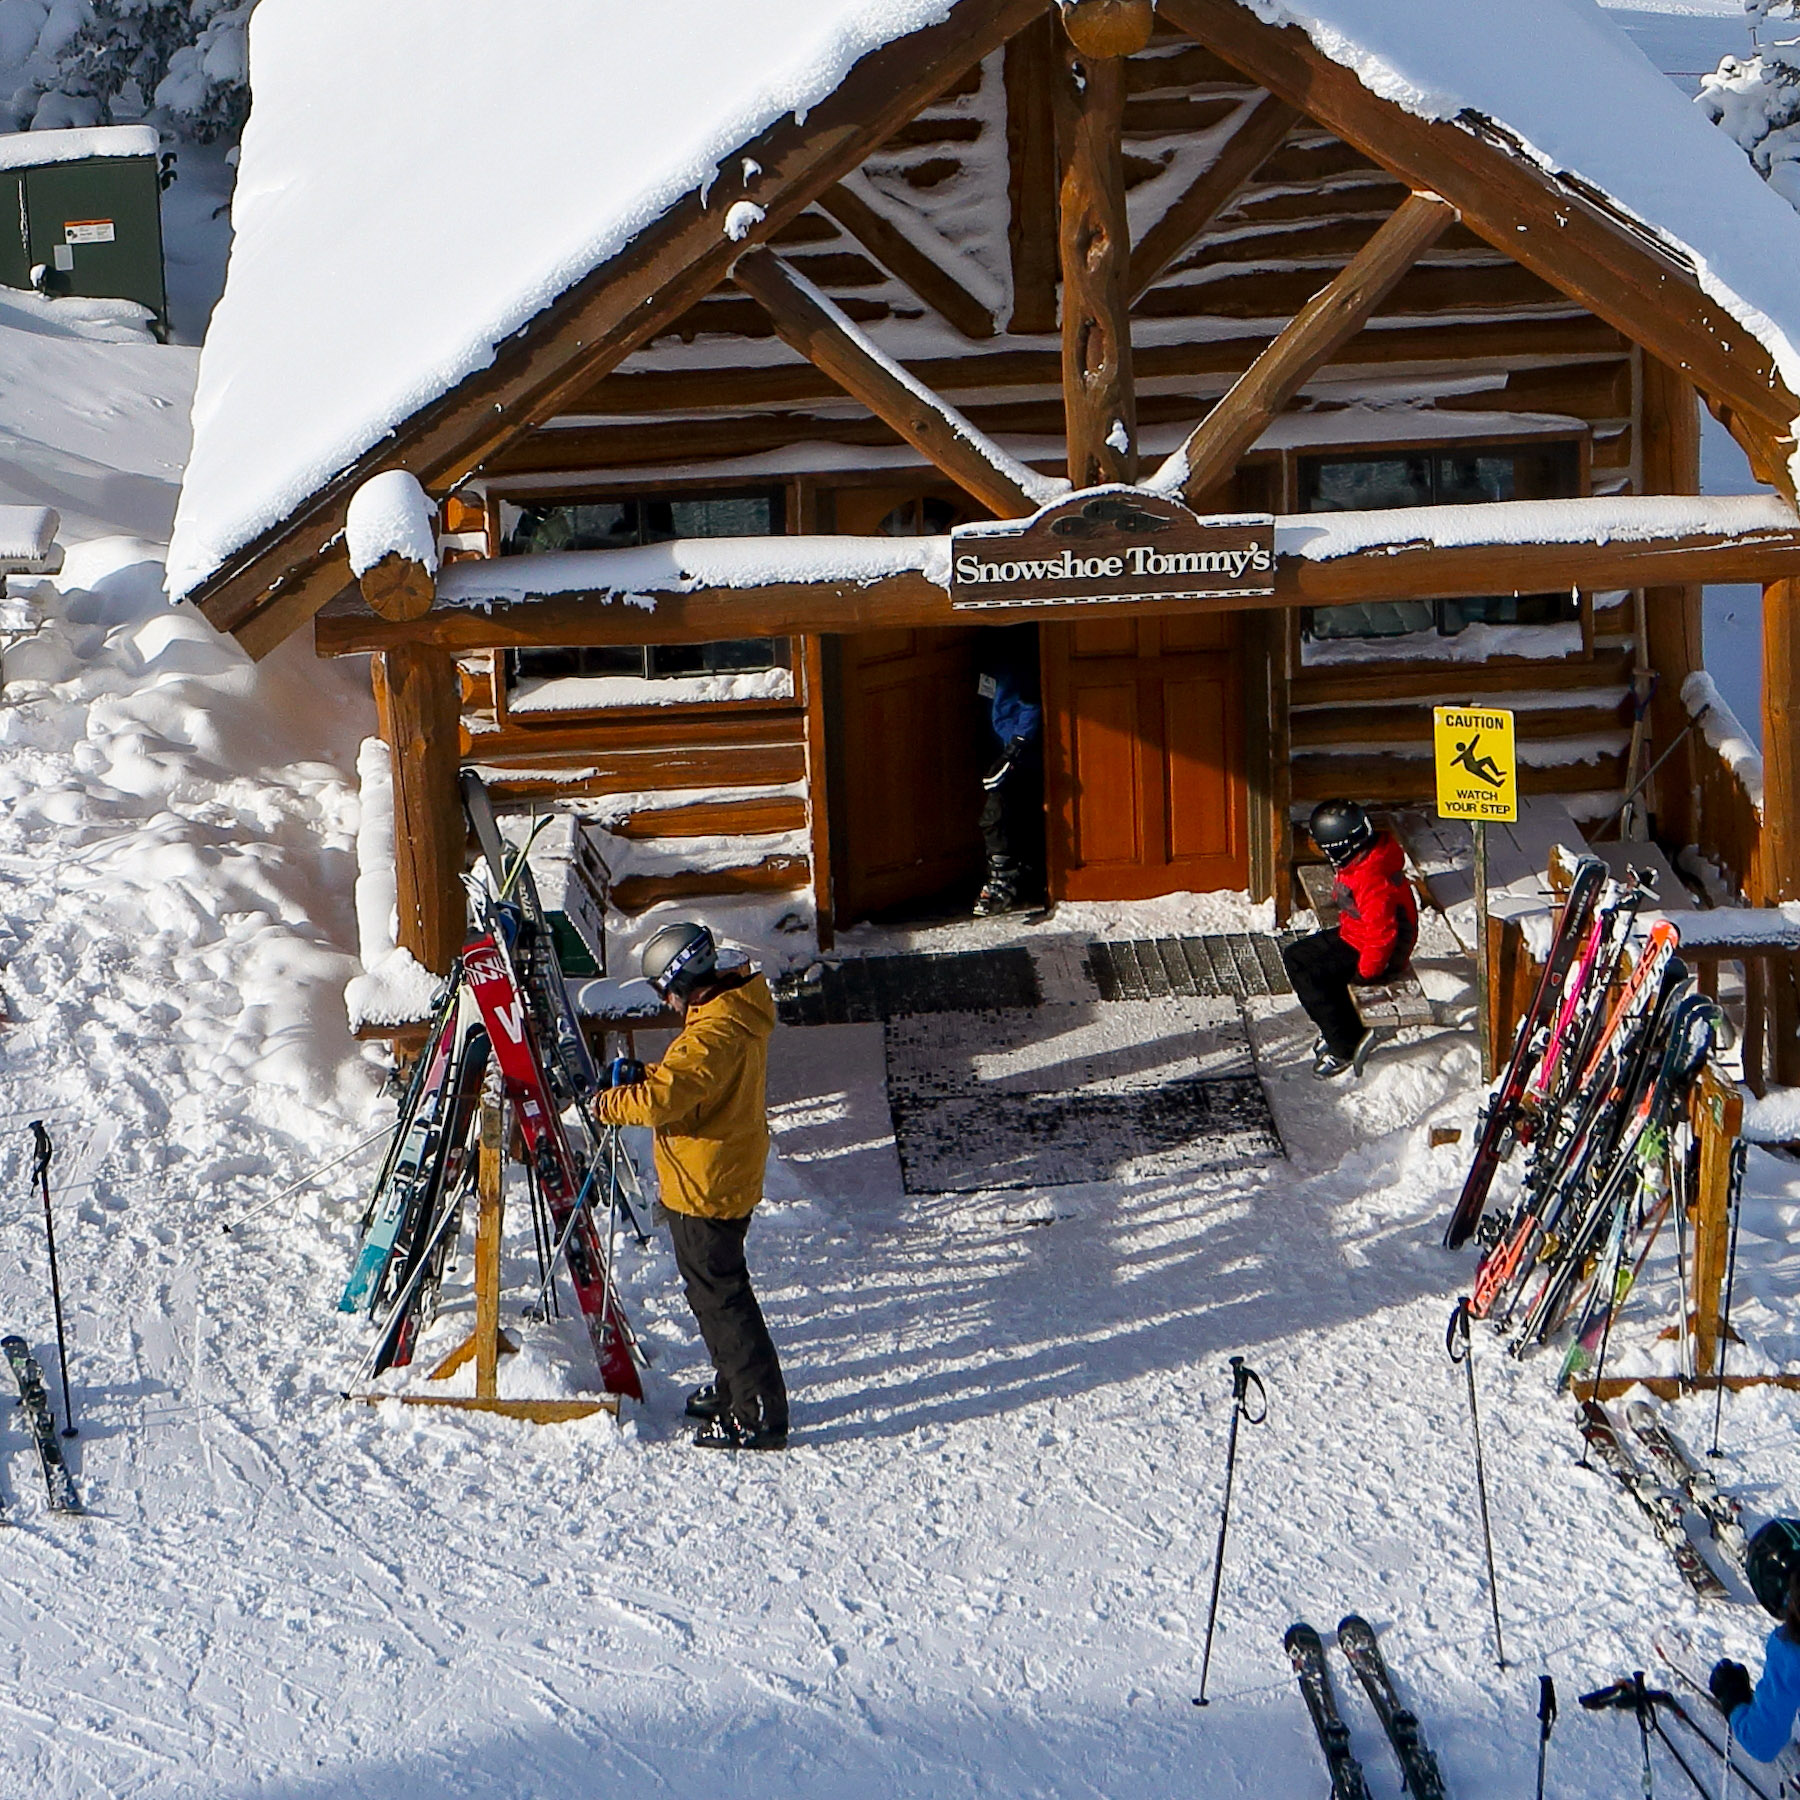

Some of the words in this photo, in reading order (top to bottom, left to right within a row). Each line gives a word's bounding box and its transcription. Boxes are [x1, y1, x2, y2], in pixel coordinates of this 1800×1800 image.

[956, 549, 1123, 586] Snowshoe
[1126, 541, 1271, 579] Tommy's
[1445, 714, 1504, 730] CAUTION
[1456, 789, 1498, 801] WATCH
[1445, 801, 1477, 813] YOUR
[1481, 803, 1511, 815] STEP
